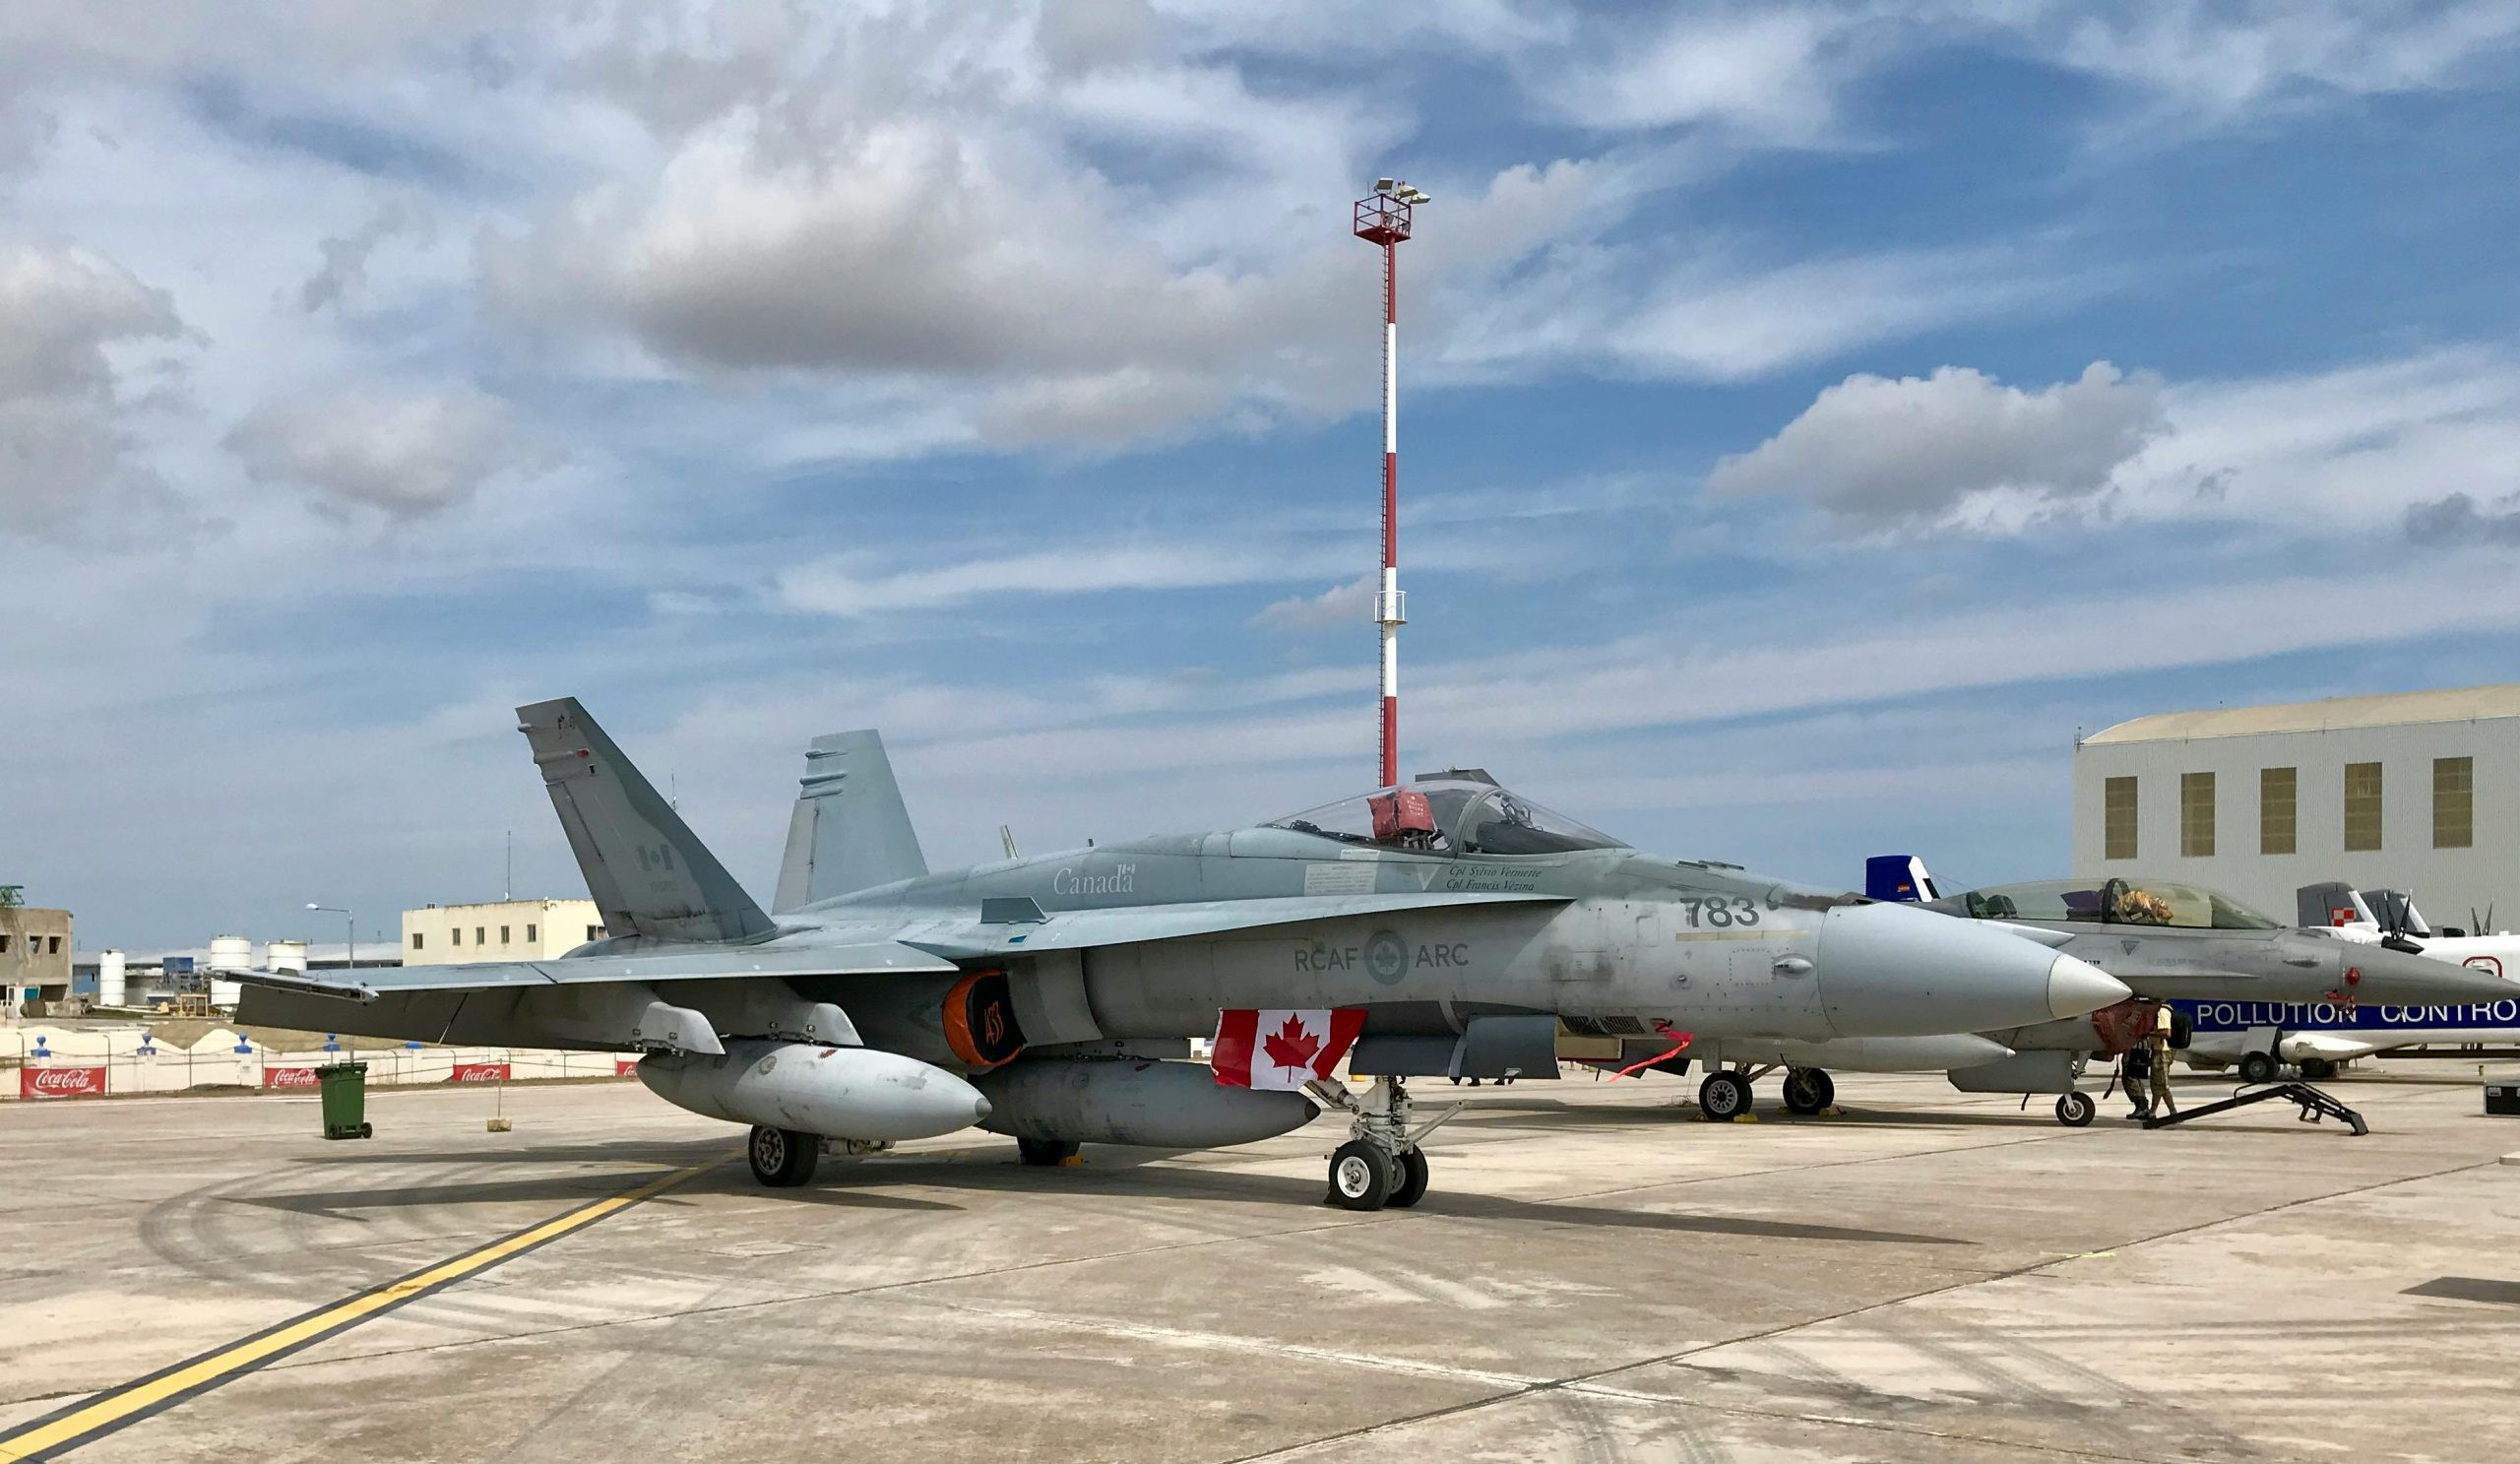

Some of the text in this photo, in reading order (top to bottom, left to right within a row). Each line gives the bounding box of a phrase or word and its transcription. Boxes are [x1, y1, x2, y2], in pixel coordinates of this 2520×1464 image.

[1053, 863, 1134, 895] Canada
[1449, 865, 1467, 877] Cpl
[1446, 878, 1464, 890] Cpl
[1466, 878, 1499, 891] Francis
[1679, 897, 1760, 927] 783
[1294, 943, 1470, 972] RCAF ARC
[2197, 1002, 2357, 1025] POLLUTION
[35, 1069, 93, 1089] Coca-Cola
